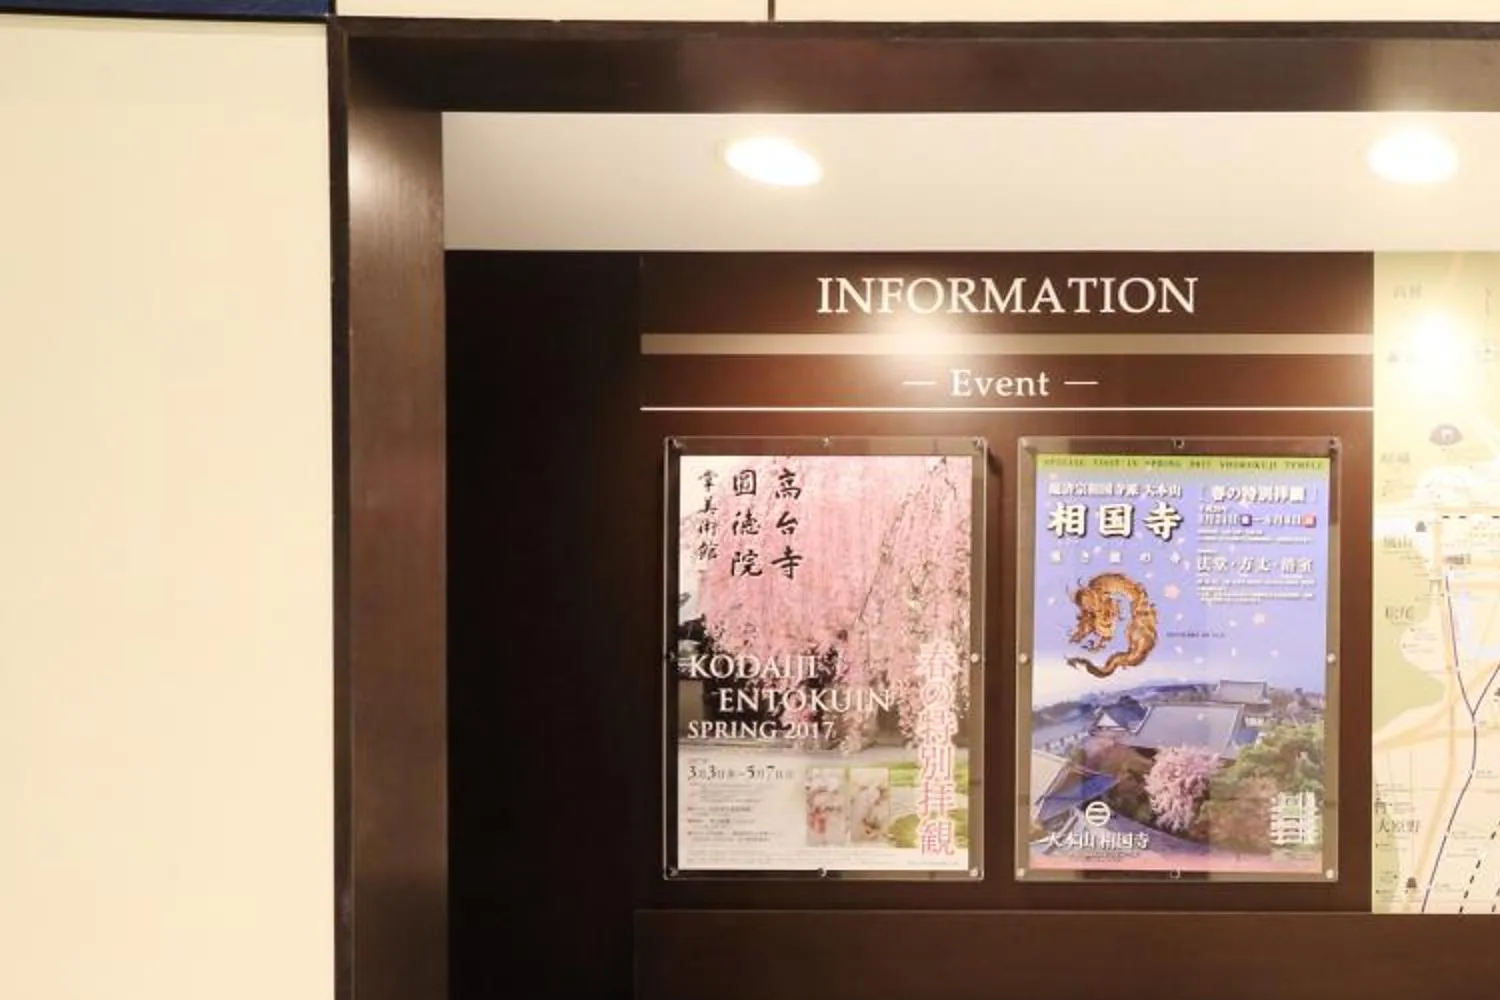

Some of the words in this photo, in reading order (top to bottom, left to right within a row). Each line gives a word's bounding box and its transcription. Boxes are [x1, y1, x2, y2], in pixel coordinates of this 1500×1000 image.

[816, 277, 1198, 314] INFORMATION
[950, 371, 1049, 397] Event
[771, 467, 803, 579] 高台寺
[1047, 501, 1184, 541] 相国寺
[689, 655, 818, 681] KODAIJI
[719, 687, 889, 713] ENTOKUIN
[687, 720, 776, 739] SPRING
[784, 720, 835, 740] 2017
